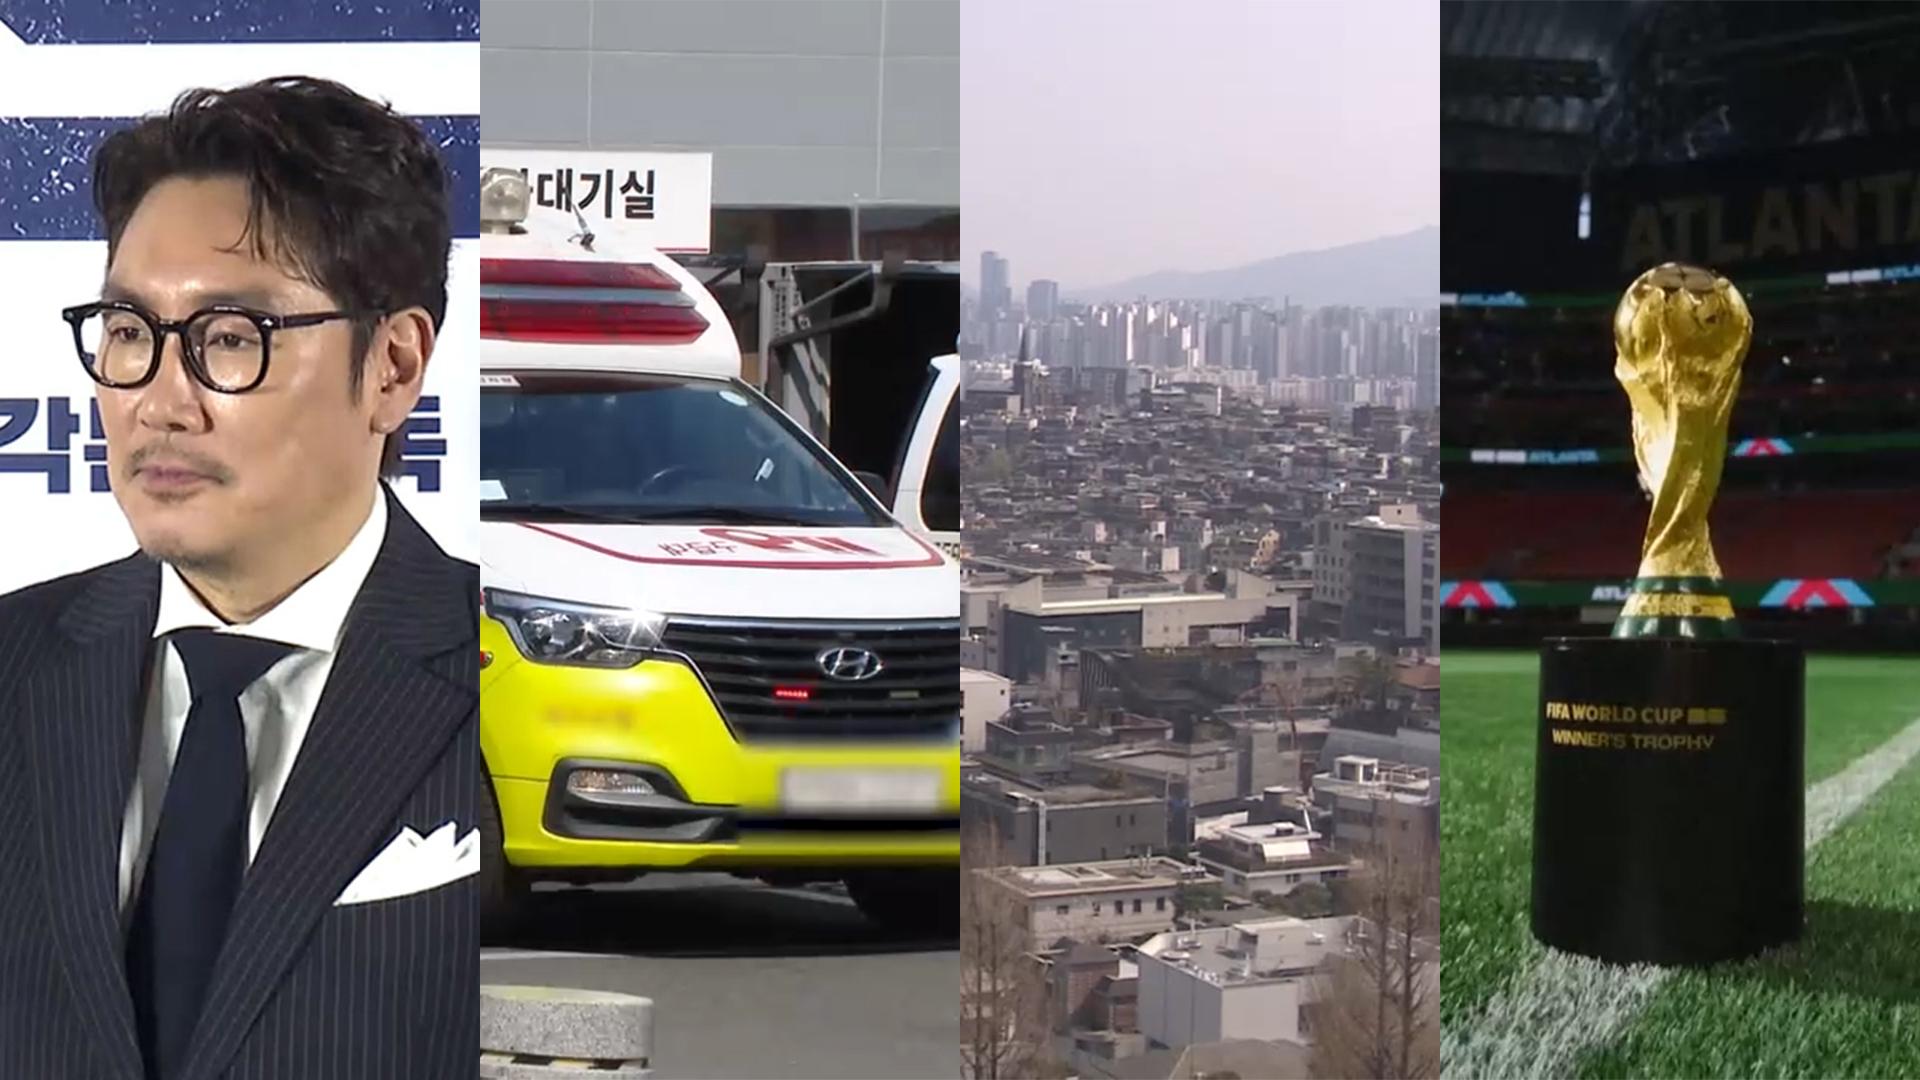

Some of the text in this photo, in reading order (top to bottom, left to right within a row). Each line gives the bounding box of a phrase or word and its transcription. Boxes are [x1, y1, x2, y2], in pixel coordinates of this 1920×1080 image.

[520, 167, 655, 219] 대기실
[1546, 702, 1570, 720] FIFA
[1572, 704, 1636, 722] WORLD
[1641, 707, 1684, 725] CUP
[1552, 728, 1715, 750] WINNER'S TROPHY
